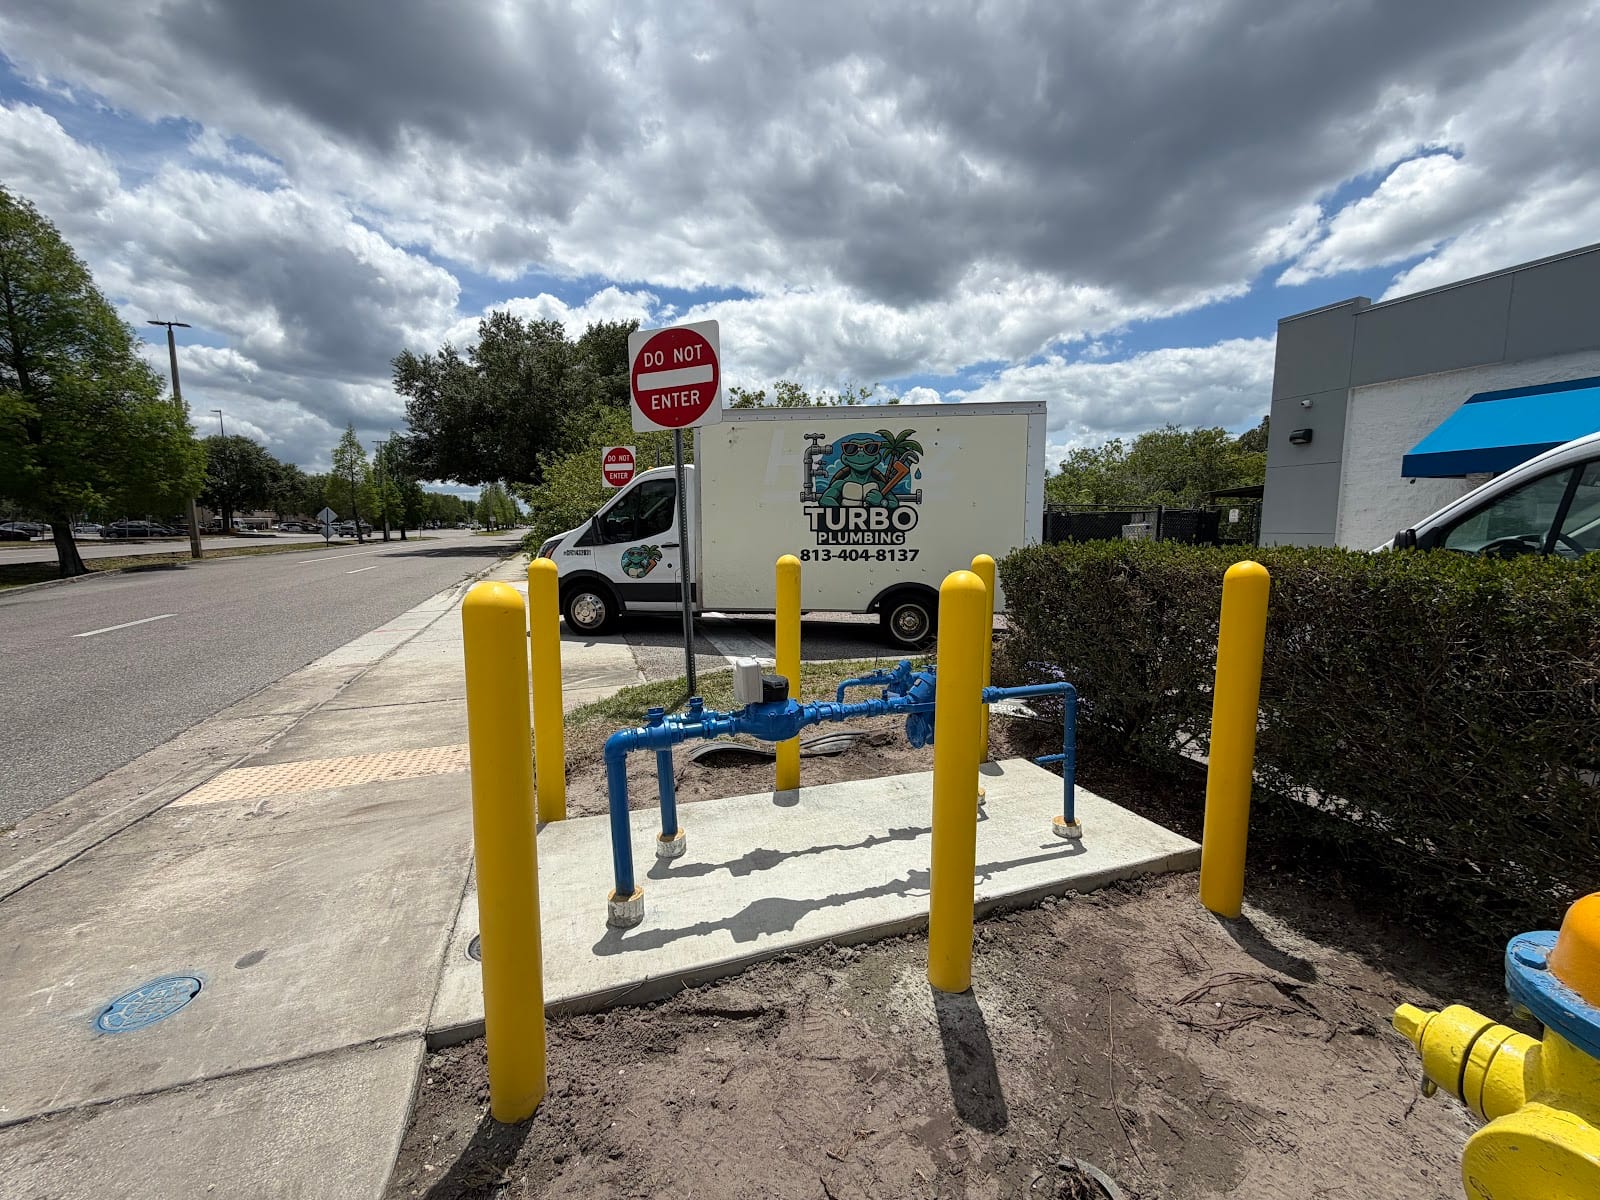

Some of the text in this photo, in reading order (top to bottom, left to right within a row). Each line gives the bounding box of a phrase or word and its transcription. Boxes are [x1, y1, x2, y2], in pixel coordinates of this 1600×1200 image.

[643, 344, 703, 367] DO NOT
[651, 390, 701, 410] ENTER
[618, 454, 630, 462] NOT
[609, 472, 629, 480] ENTER
[804, 506, 917, 531] TURBO
[817, 531, 905, 544] PLUMBING
[800, 549, 920, 562] 813-404-8137
